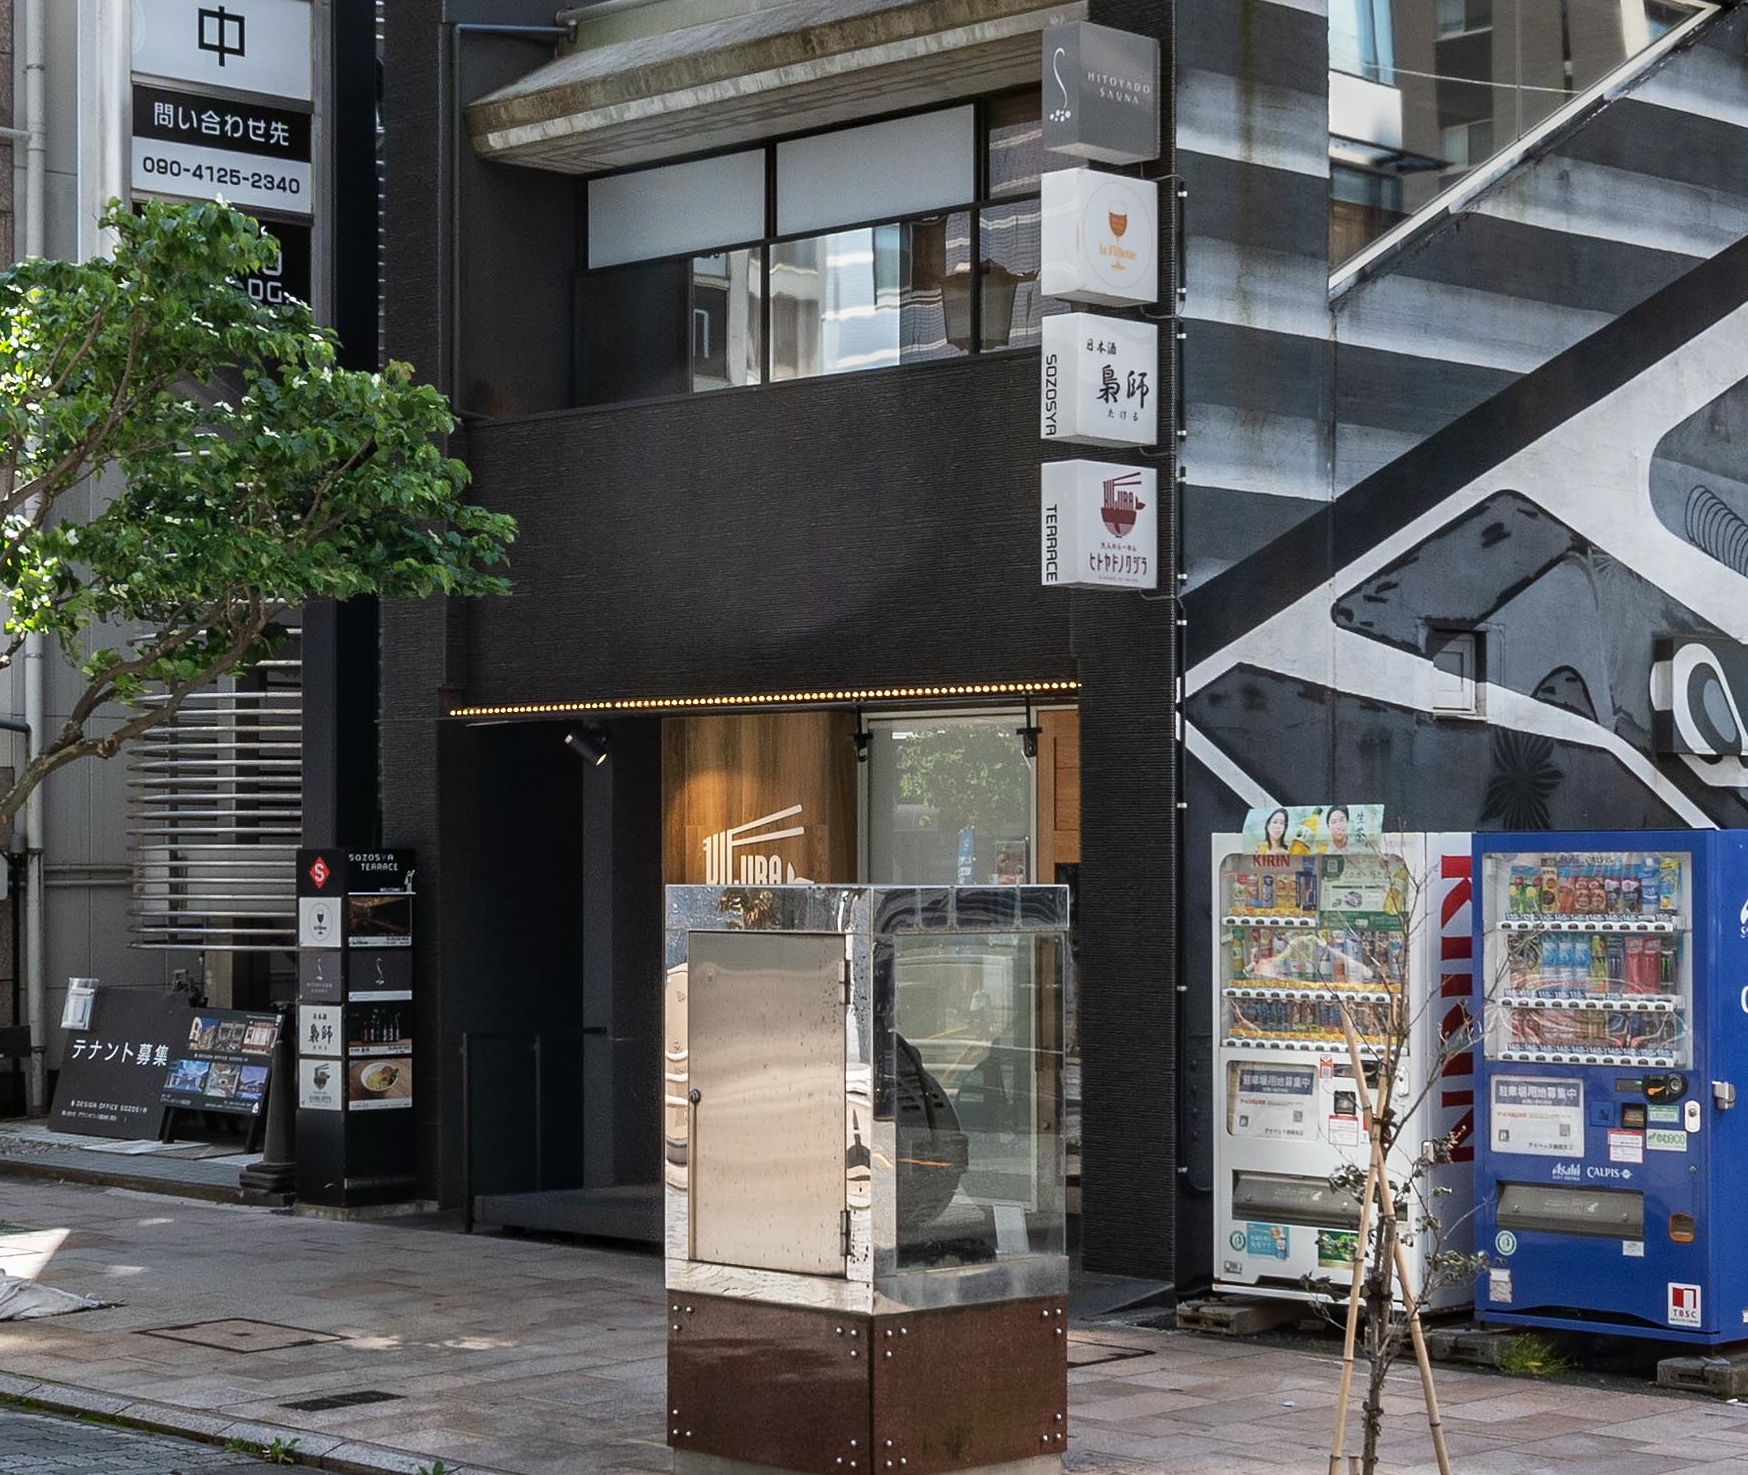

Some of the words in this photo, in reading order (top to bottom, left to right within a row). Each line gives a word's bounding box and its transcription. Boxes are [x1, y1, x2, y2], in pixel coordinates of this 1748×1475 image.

[1087, 71, 1150, 94] HITOYADO
[1099, 87, 1139, 105] SAUNA
[154, 101, 290, 146] 問い合わせ先
[142, 156, 300, 194] 090-4125-2340
[1045, 353, 1058, 436] SOZOSYA
[1045, 504, 1058, 582] TERRACE
[1089, 552, 1148, 576] ヒトヤドノクジラ
[360, 863, 399, 871] TERRACE
[1252, 854, 1291, 868] KIRIN
[72, 1039, 170, 1067] テナント募集
[76, 1100, 98, 1109] DESIGN
[99, 1101, 118, 1111] OFFICE
[1552, 1162, 1581, 1176] Asahi
[1586, 1166, 1620, 1178] CALPIS
[1672, 1308, 1698, 1319] TBSC
